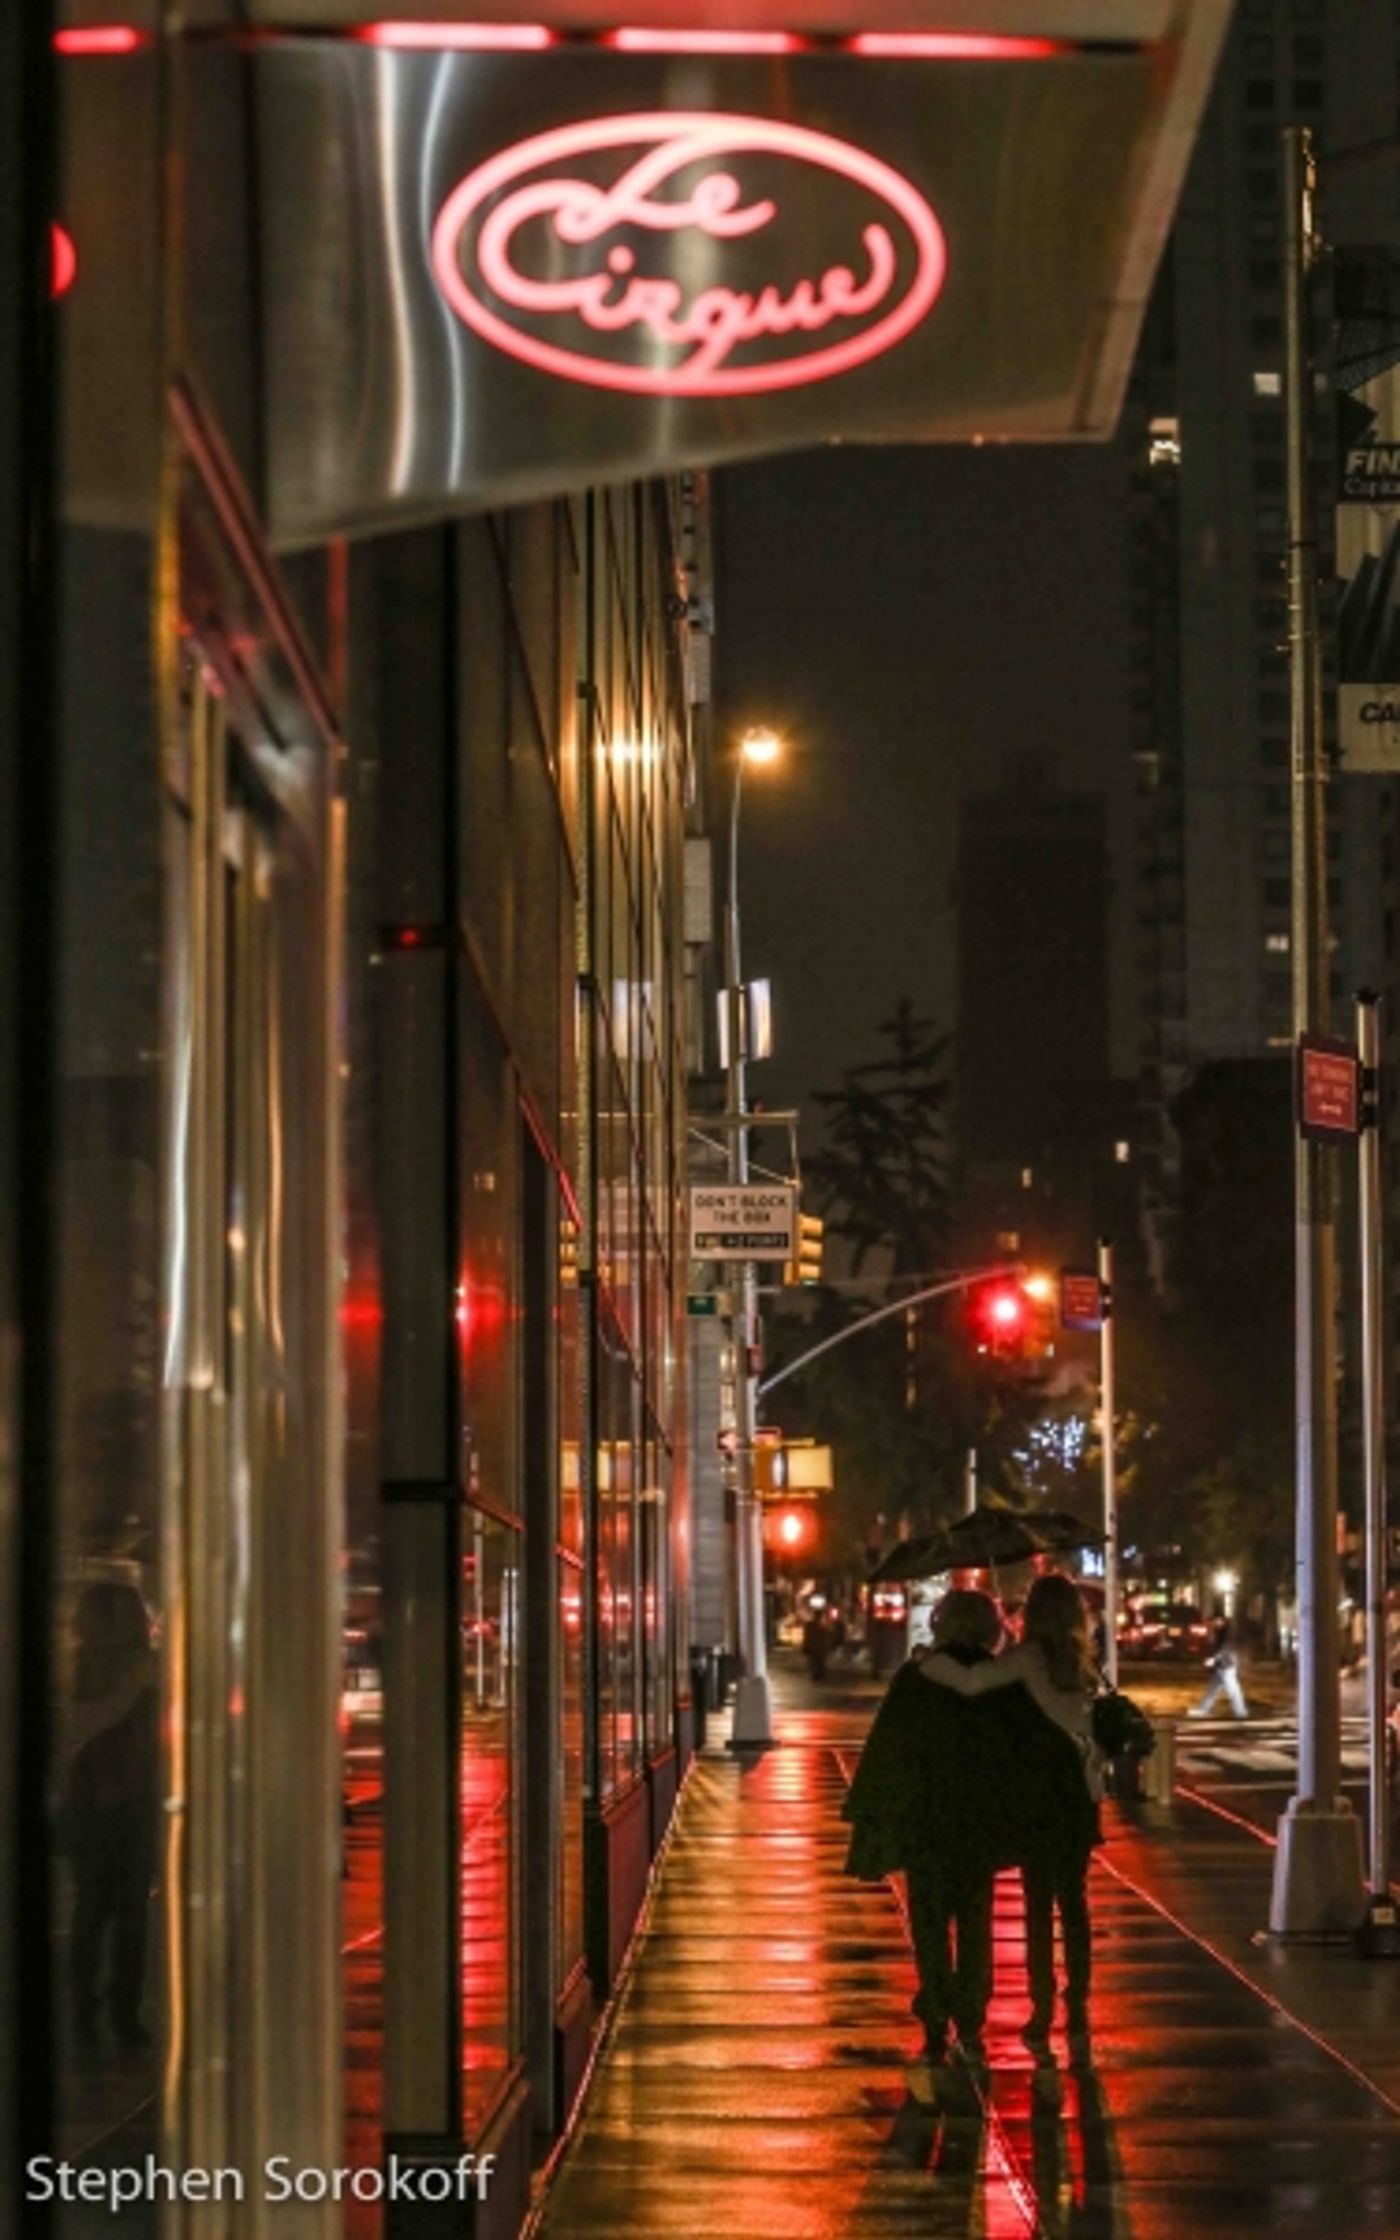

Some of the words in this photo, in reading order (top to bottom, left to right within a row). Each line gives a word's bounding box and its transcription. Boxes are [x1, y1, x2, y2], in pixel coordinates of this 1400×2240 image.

[554, 138, 777, 243] Le
[477, 178, 896, 378] Cirque
[713, 1210, 739, 1224] THE
[741, 1194, 787, 1208] BLOCK
